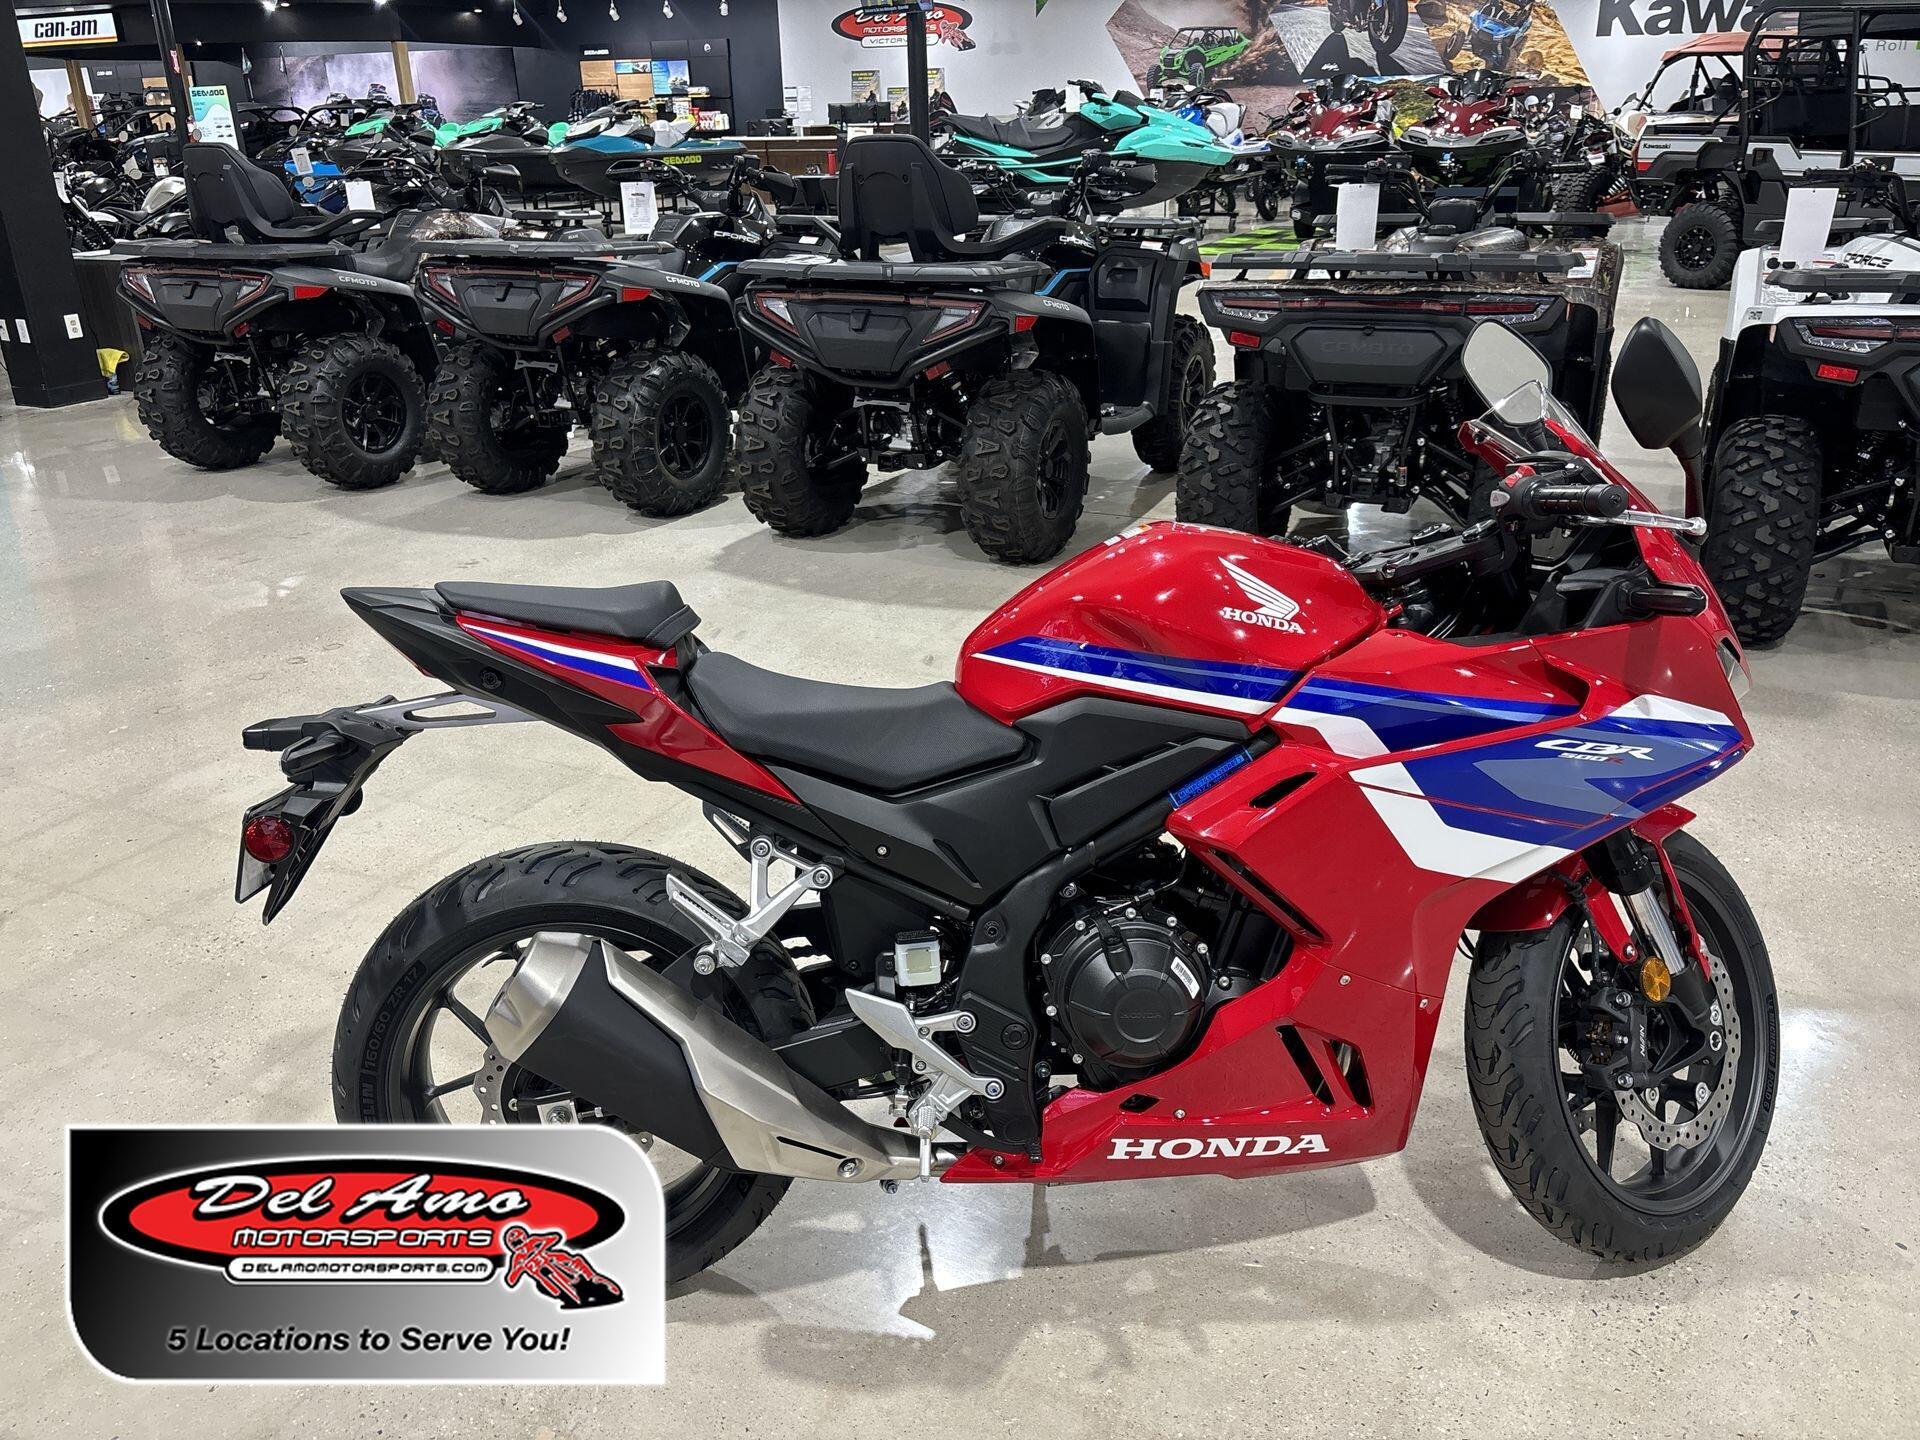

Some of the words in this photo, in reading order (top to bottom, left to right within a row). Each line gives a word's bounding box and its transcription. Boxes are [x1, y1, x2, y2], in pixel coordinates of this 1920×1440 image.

[34, 19, 99, 38] can-am
[863, 24, 937, 34] MOTORSPTS
[1596, 0, 1768, 37] Kawa
[1875, 40, 1908, 51] Roll
[338, 275, 378, 287] CFMOTO
[665, 275, 701, 288] CFMOTO
[1221, 606, 1306, 635] HONDA
[1534, 739, 1655, 761] CBR
[364, 1011, 391, 1070] 160/60
[388, 986, 406, 1008] ZR
[404, 967, 418, 984] 17
[1637, 1023, 1646, 1058] NISSIN
[1766, 1072, 1775, 1100] ROAD
[1106, 1133, 1330, 1160] HONDA
